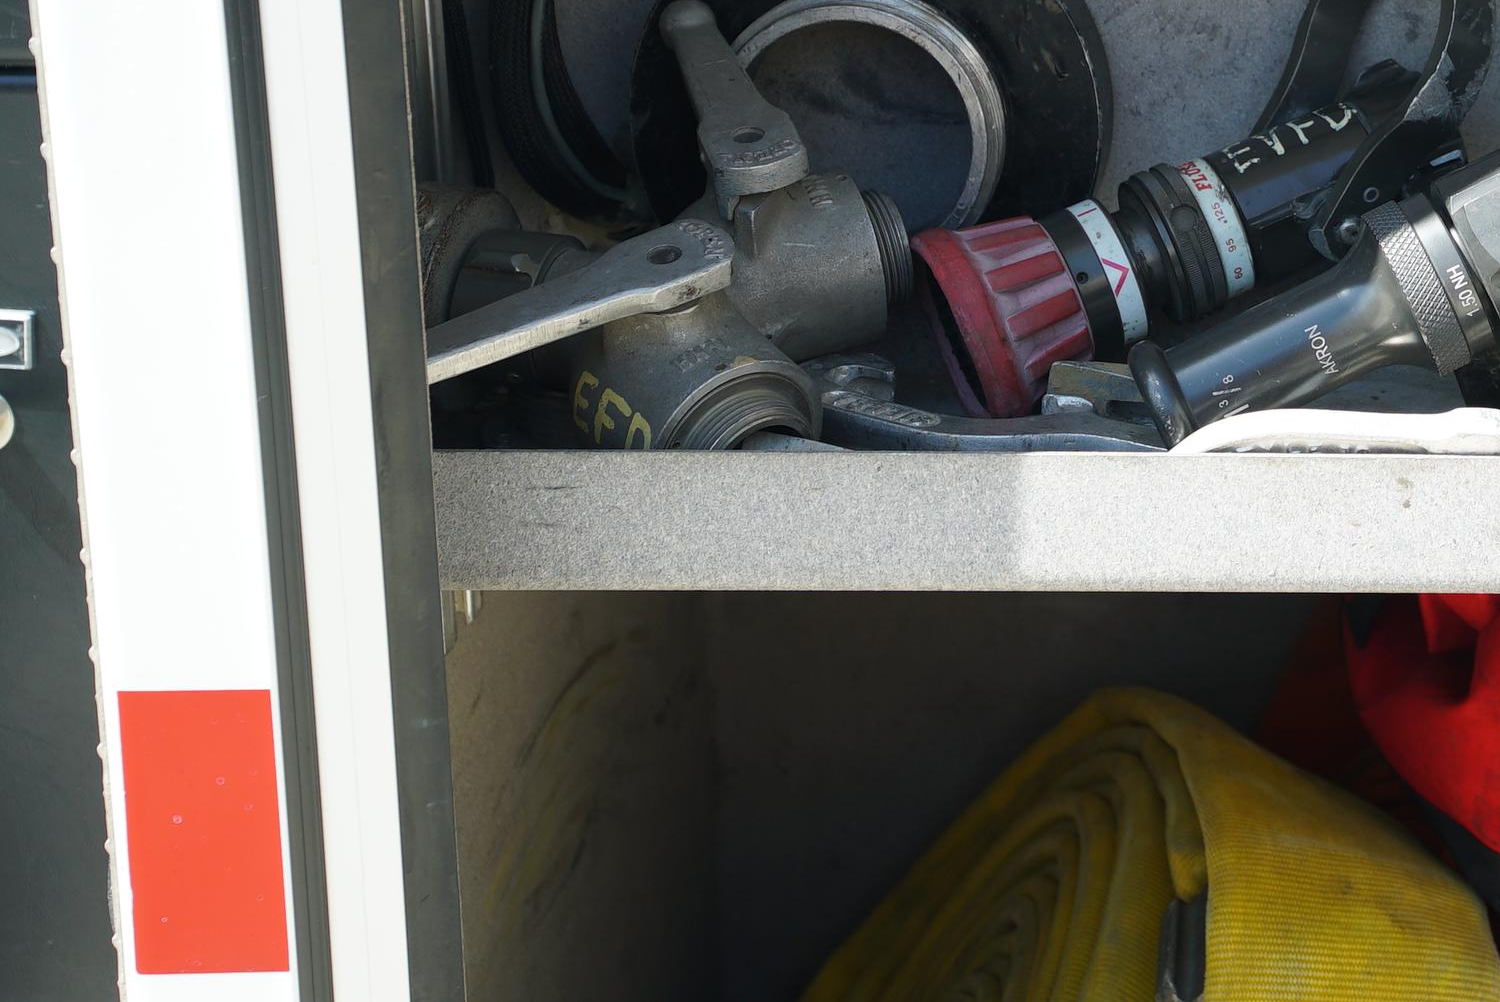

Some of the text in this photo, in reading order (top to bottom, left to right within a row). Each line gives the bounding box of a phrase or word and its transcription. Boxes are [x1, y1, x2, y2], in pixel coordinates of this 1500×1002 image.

[1225, 237, 1237, 253] 95
[1446, 262, 1481, 318] 1.50 NH
[1303, 323, 1340, 376] AKRON
